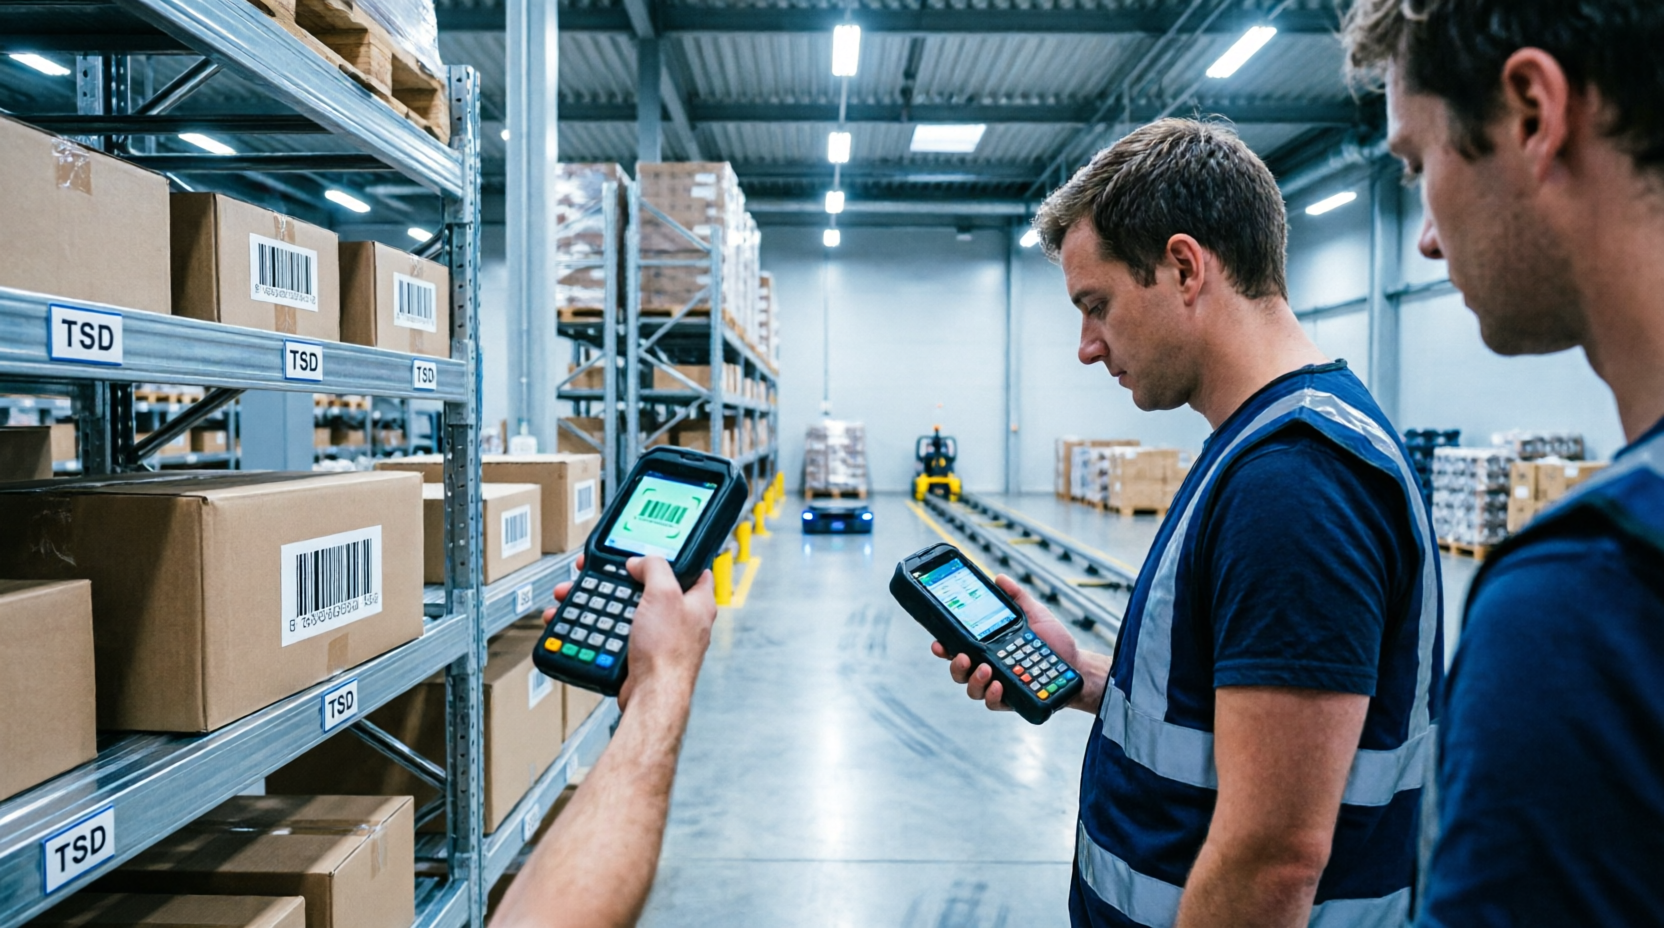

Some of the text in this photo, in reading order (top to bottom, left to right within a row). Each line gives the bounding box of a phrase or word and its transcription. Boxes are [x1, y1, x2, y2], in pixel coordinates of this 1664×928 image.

[61, 318, 114, 351] TSD
[289, 349, 319, 373] TSD
[416, 366, 435, 384] TSD
[328, 690, 354, 719] TSD
[55, 825, 107, 873] TSD
